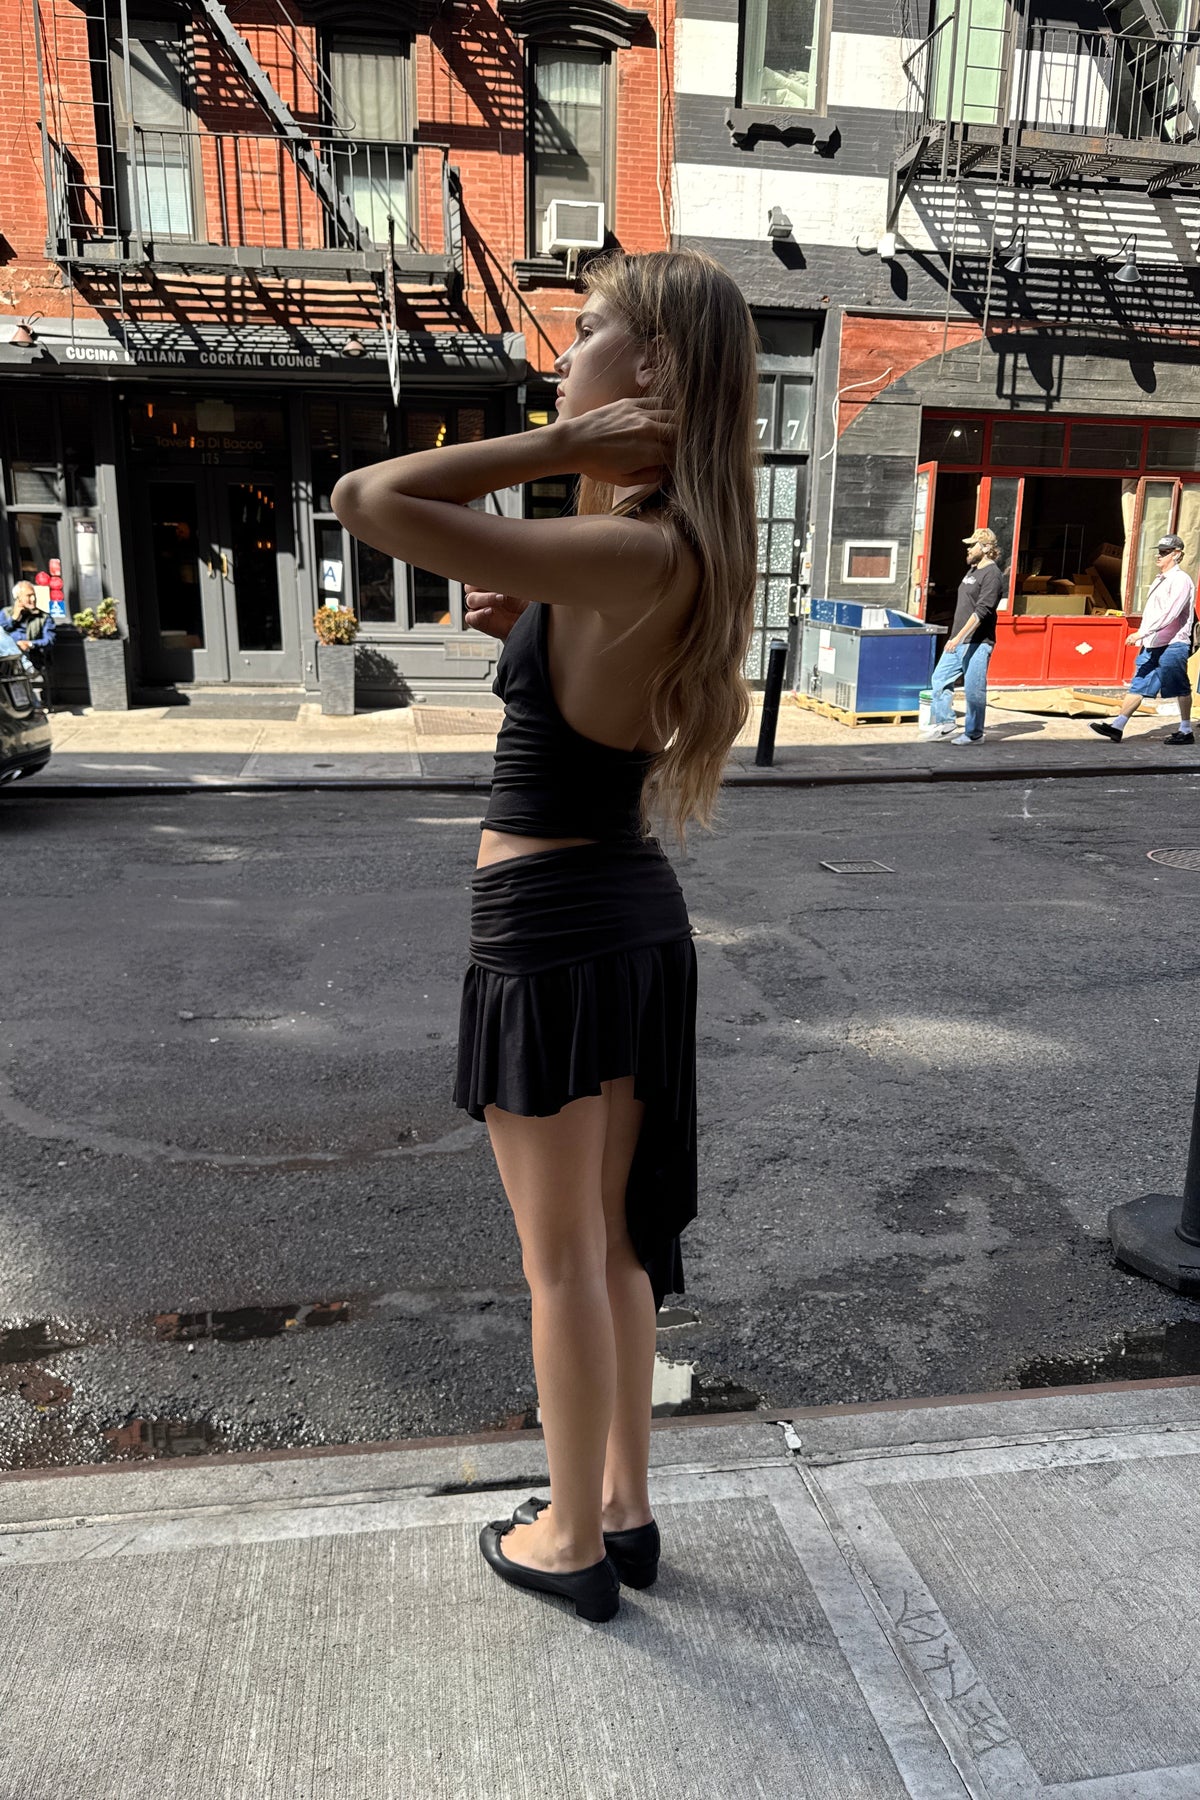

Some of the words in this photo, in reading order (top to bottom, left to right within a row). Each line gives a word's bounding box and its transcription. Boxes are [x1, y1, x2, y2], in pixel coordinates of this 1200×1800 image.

[66, 346, 118, 361] CUCINA
[124, 350, 186, 363] ITALIANA
[200, 352, 263, 365] COCKTAIL
[270, 355, 321, 367] LOUNGE
[154, 436, 205, 448] Tavera
[208, 436, 221, 448] Di
[224, 437, 263, 450] Bacco
[323, 566, 336, 582] A
